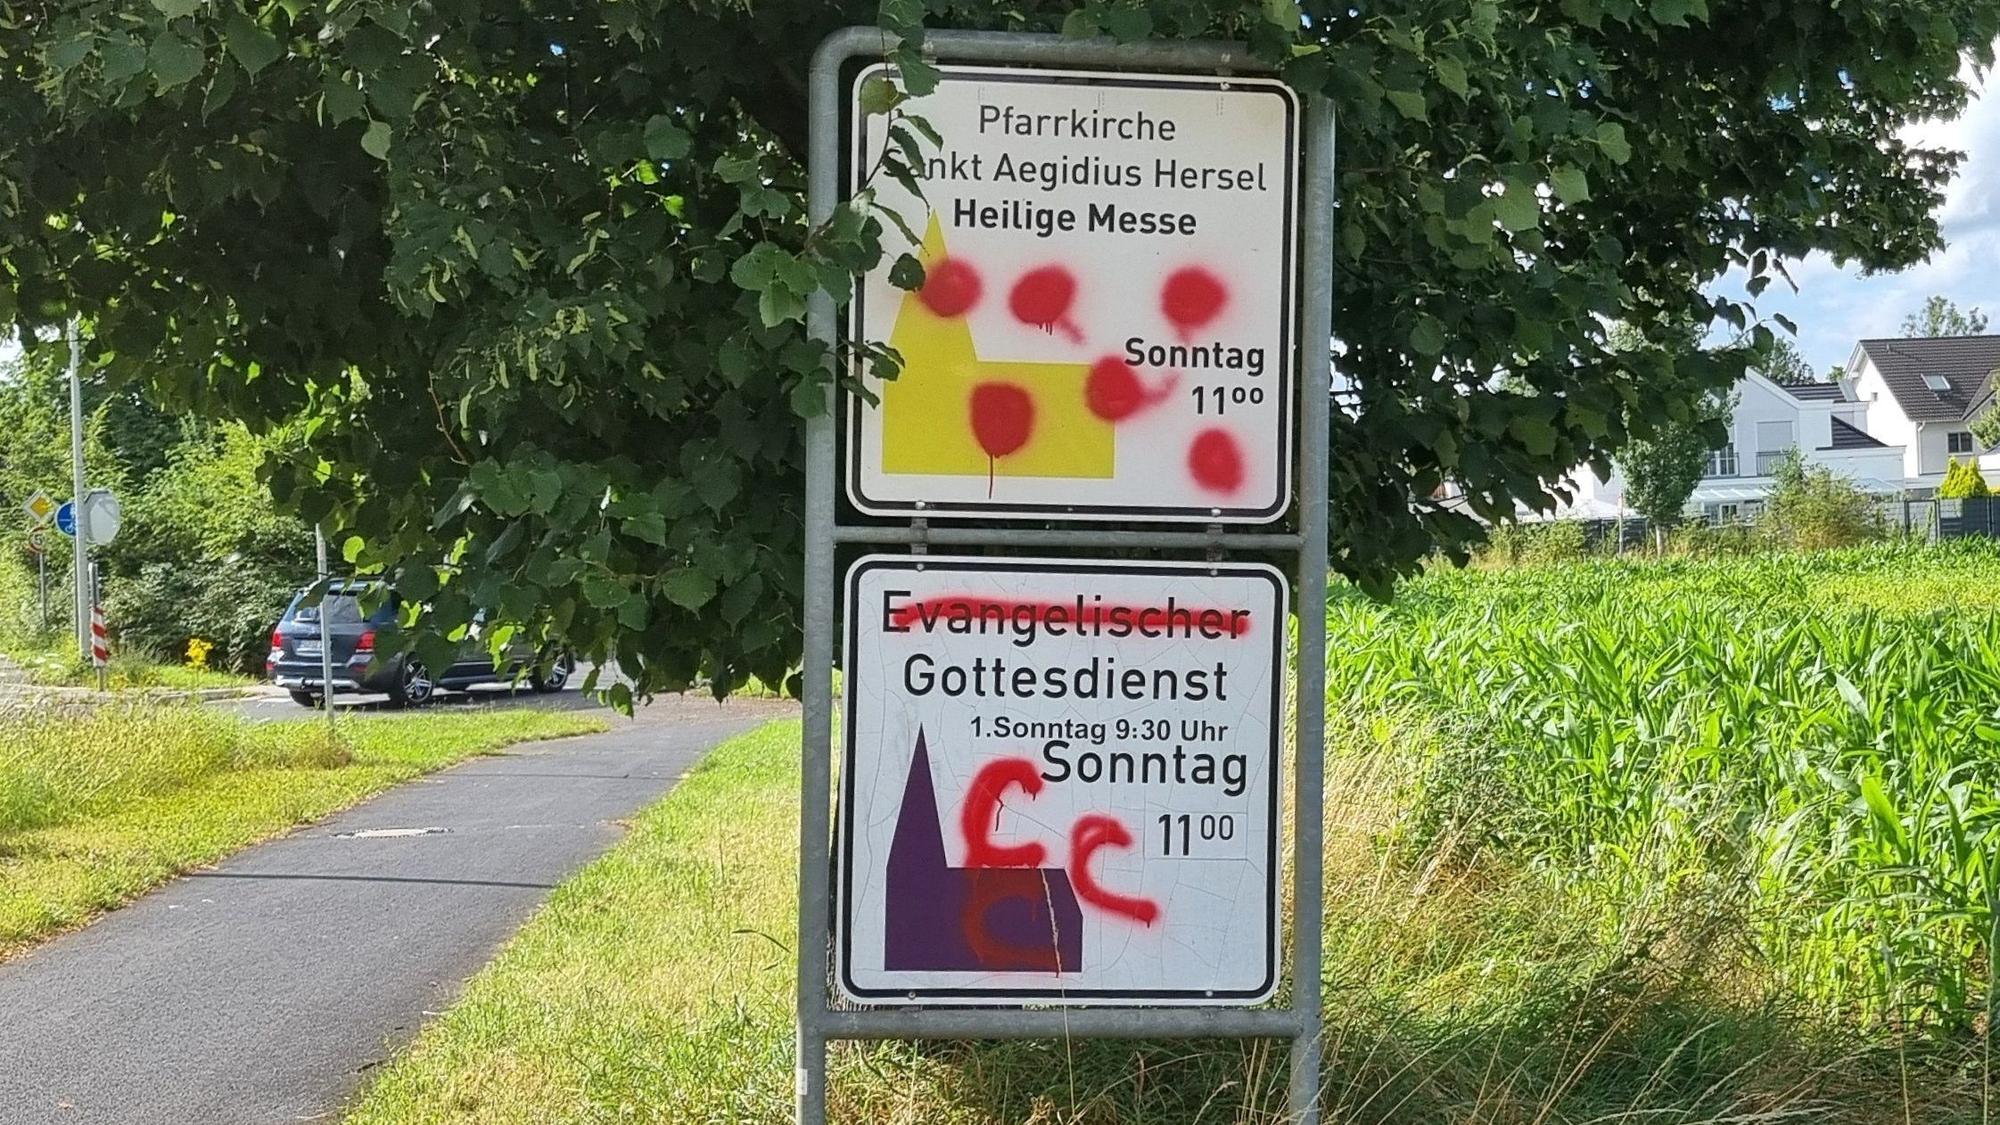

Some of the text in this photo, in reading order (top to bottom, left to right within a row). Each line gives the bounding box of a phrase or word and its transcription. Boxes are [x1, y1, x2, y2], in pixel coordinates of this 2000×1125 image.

[980, 105, 1176, 141] Pfarrkirche
[993, 153, 1142, 192] Aegidius
[1156, 159, 1267, 192] Hersel
[955, 199, 1197, 237] Heilige Messe
[1125, 337, 1264, 376] Sonntag
[883, 590, 1250, 647] Evangelischer
[905, 654, 1228, 702] Gottesdienst
[971, 716, 1229, 744] 1.Sonntag 9:30 Uhr
[1041, 741, 1247, 796] Sonntag
